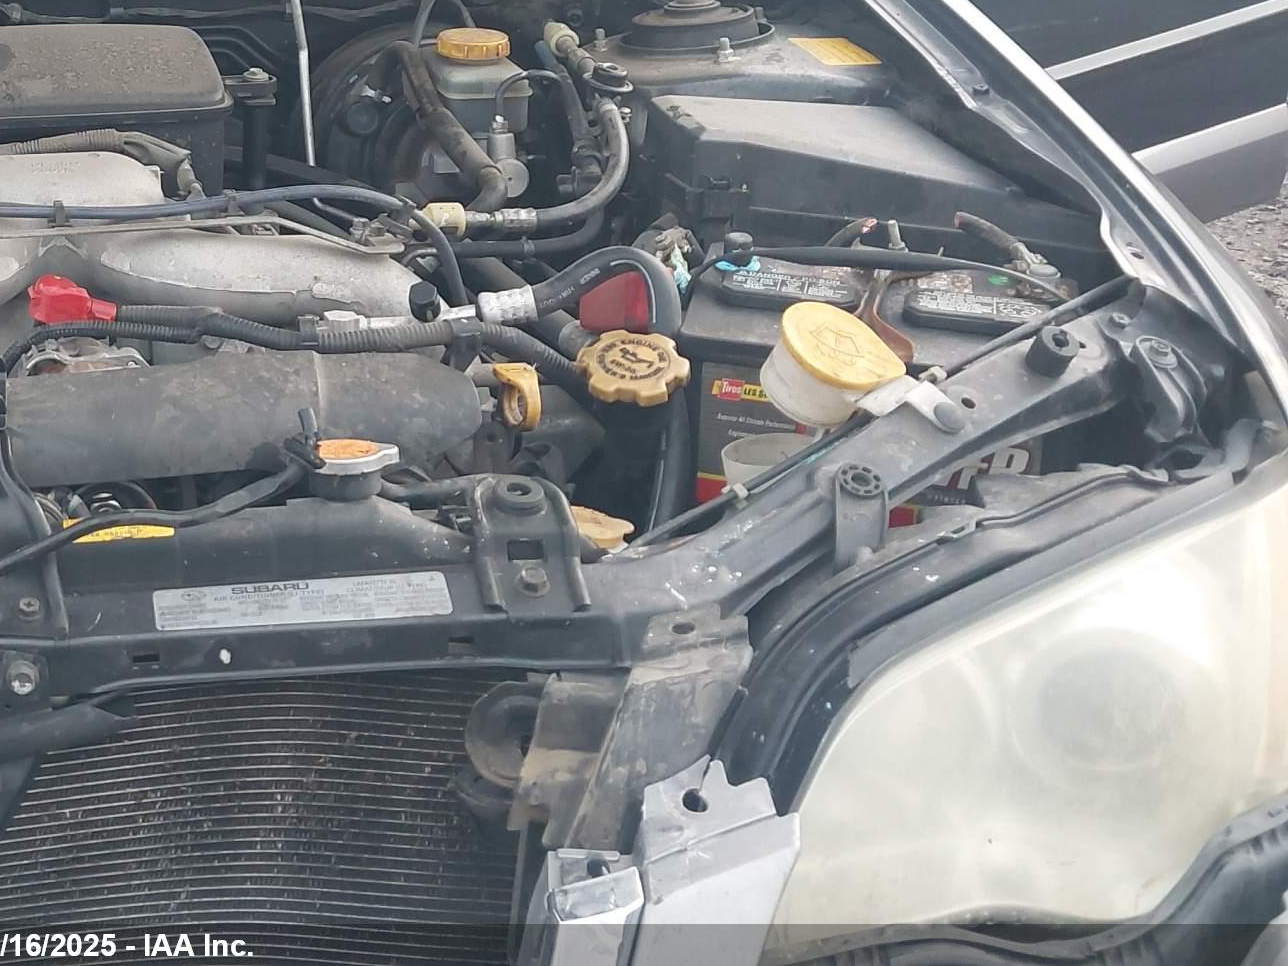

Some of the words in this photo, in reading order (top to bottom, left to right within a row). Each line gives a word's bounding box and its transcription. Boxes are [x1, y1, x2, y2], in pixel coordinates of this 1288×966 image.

[620, 337, 661, 352] ENGINE
[721, 380, 742, 394] Tires
[231, 581, 310, 595] SUBARU
